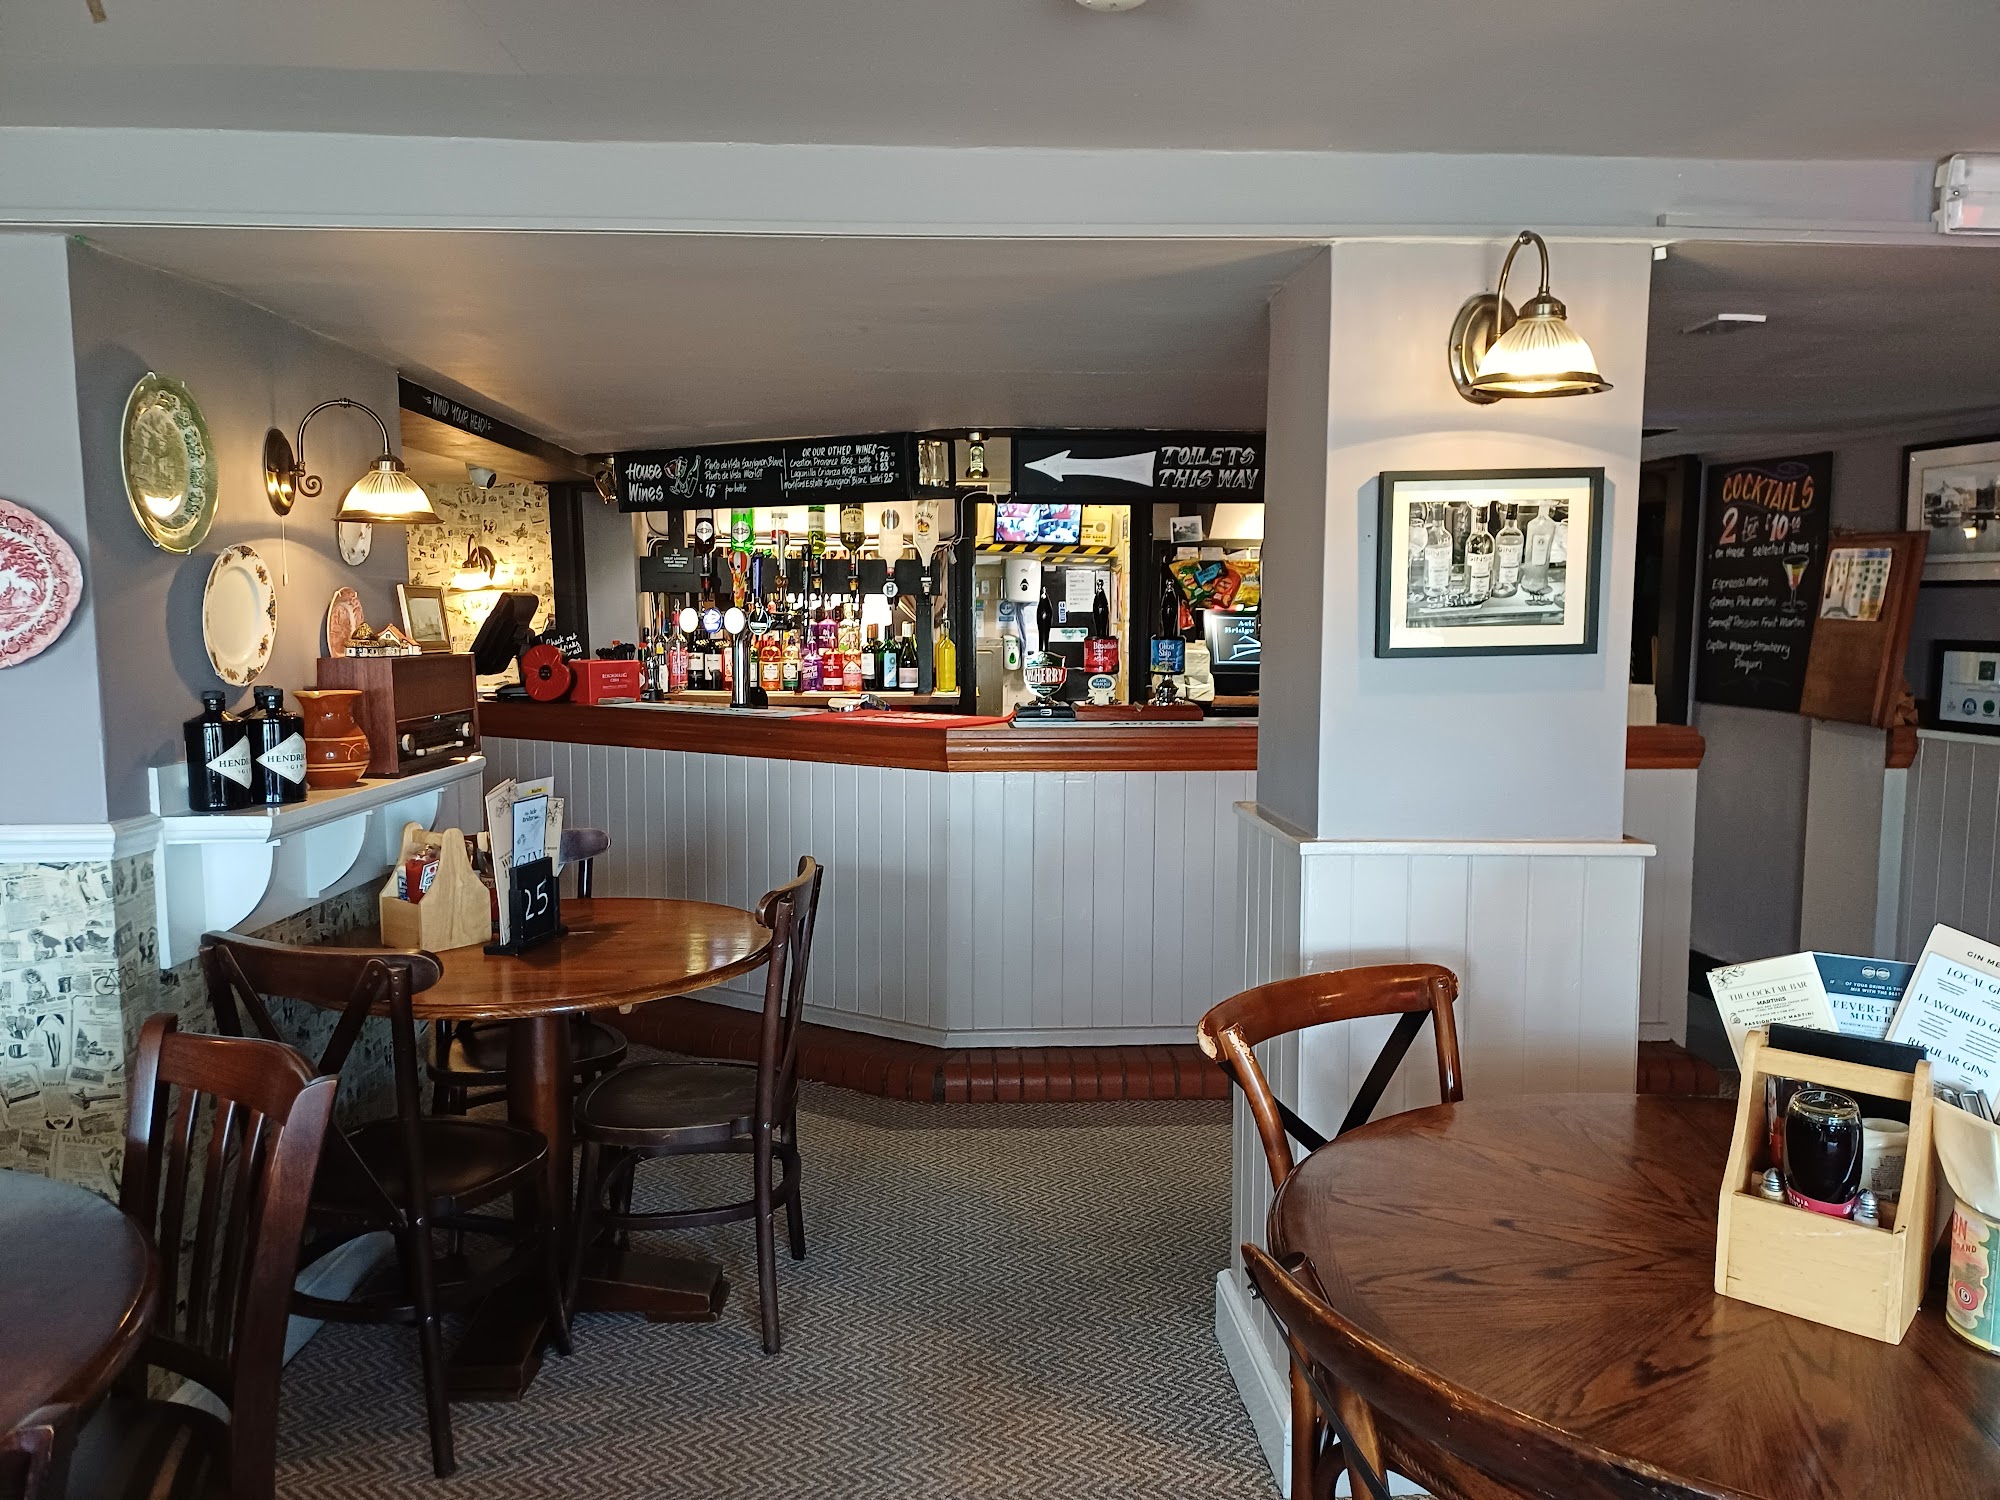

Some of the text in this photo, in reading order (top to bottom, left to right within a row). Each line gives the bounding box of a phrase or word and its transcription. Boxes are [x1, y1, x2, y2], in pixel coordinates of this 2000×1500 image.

[432, 394, 450, 416] MIND
[451, 404, 469, 428] YOUR
[812, 447, 825, 457] OUR
[828, 445, 852, 456] OTHER
[855, 444, 877, 455] WINES
[1161, 446, 1255, 466] TOILETS
[625, 463, 662, 480] House
[1159, 468, 1259, 489] THIS WAY
[628, 482, 663, 502] Wines
[1722, 473, 1814, 512] COCKTAILS
[1720, 507, 1739, 545] 2
[1753, 542, 1785, 557] selected
[1788, 541, 1809, 554] items
[545, 632, 577, 646] Check out
[1159, 642, 1175, 650] Ghost
[1026, 667, 1064, 683] WHERRY
[524, 878, 549, 921] 25
[1967, 951, 1985, 962] GIN
[1946, 967, 1985, 989] LOCAL
[1729, 981, 1807, 1001] THE COCKTAIL BAR
[1756, 997, 1787, 1005] MARTINIS
[1918, 993, 1986, 1027] FLAVOURED
[1907, 1036, 1959, 1066] REGULAR
[1962, 1061, 1990, 1078] GINS
